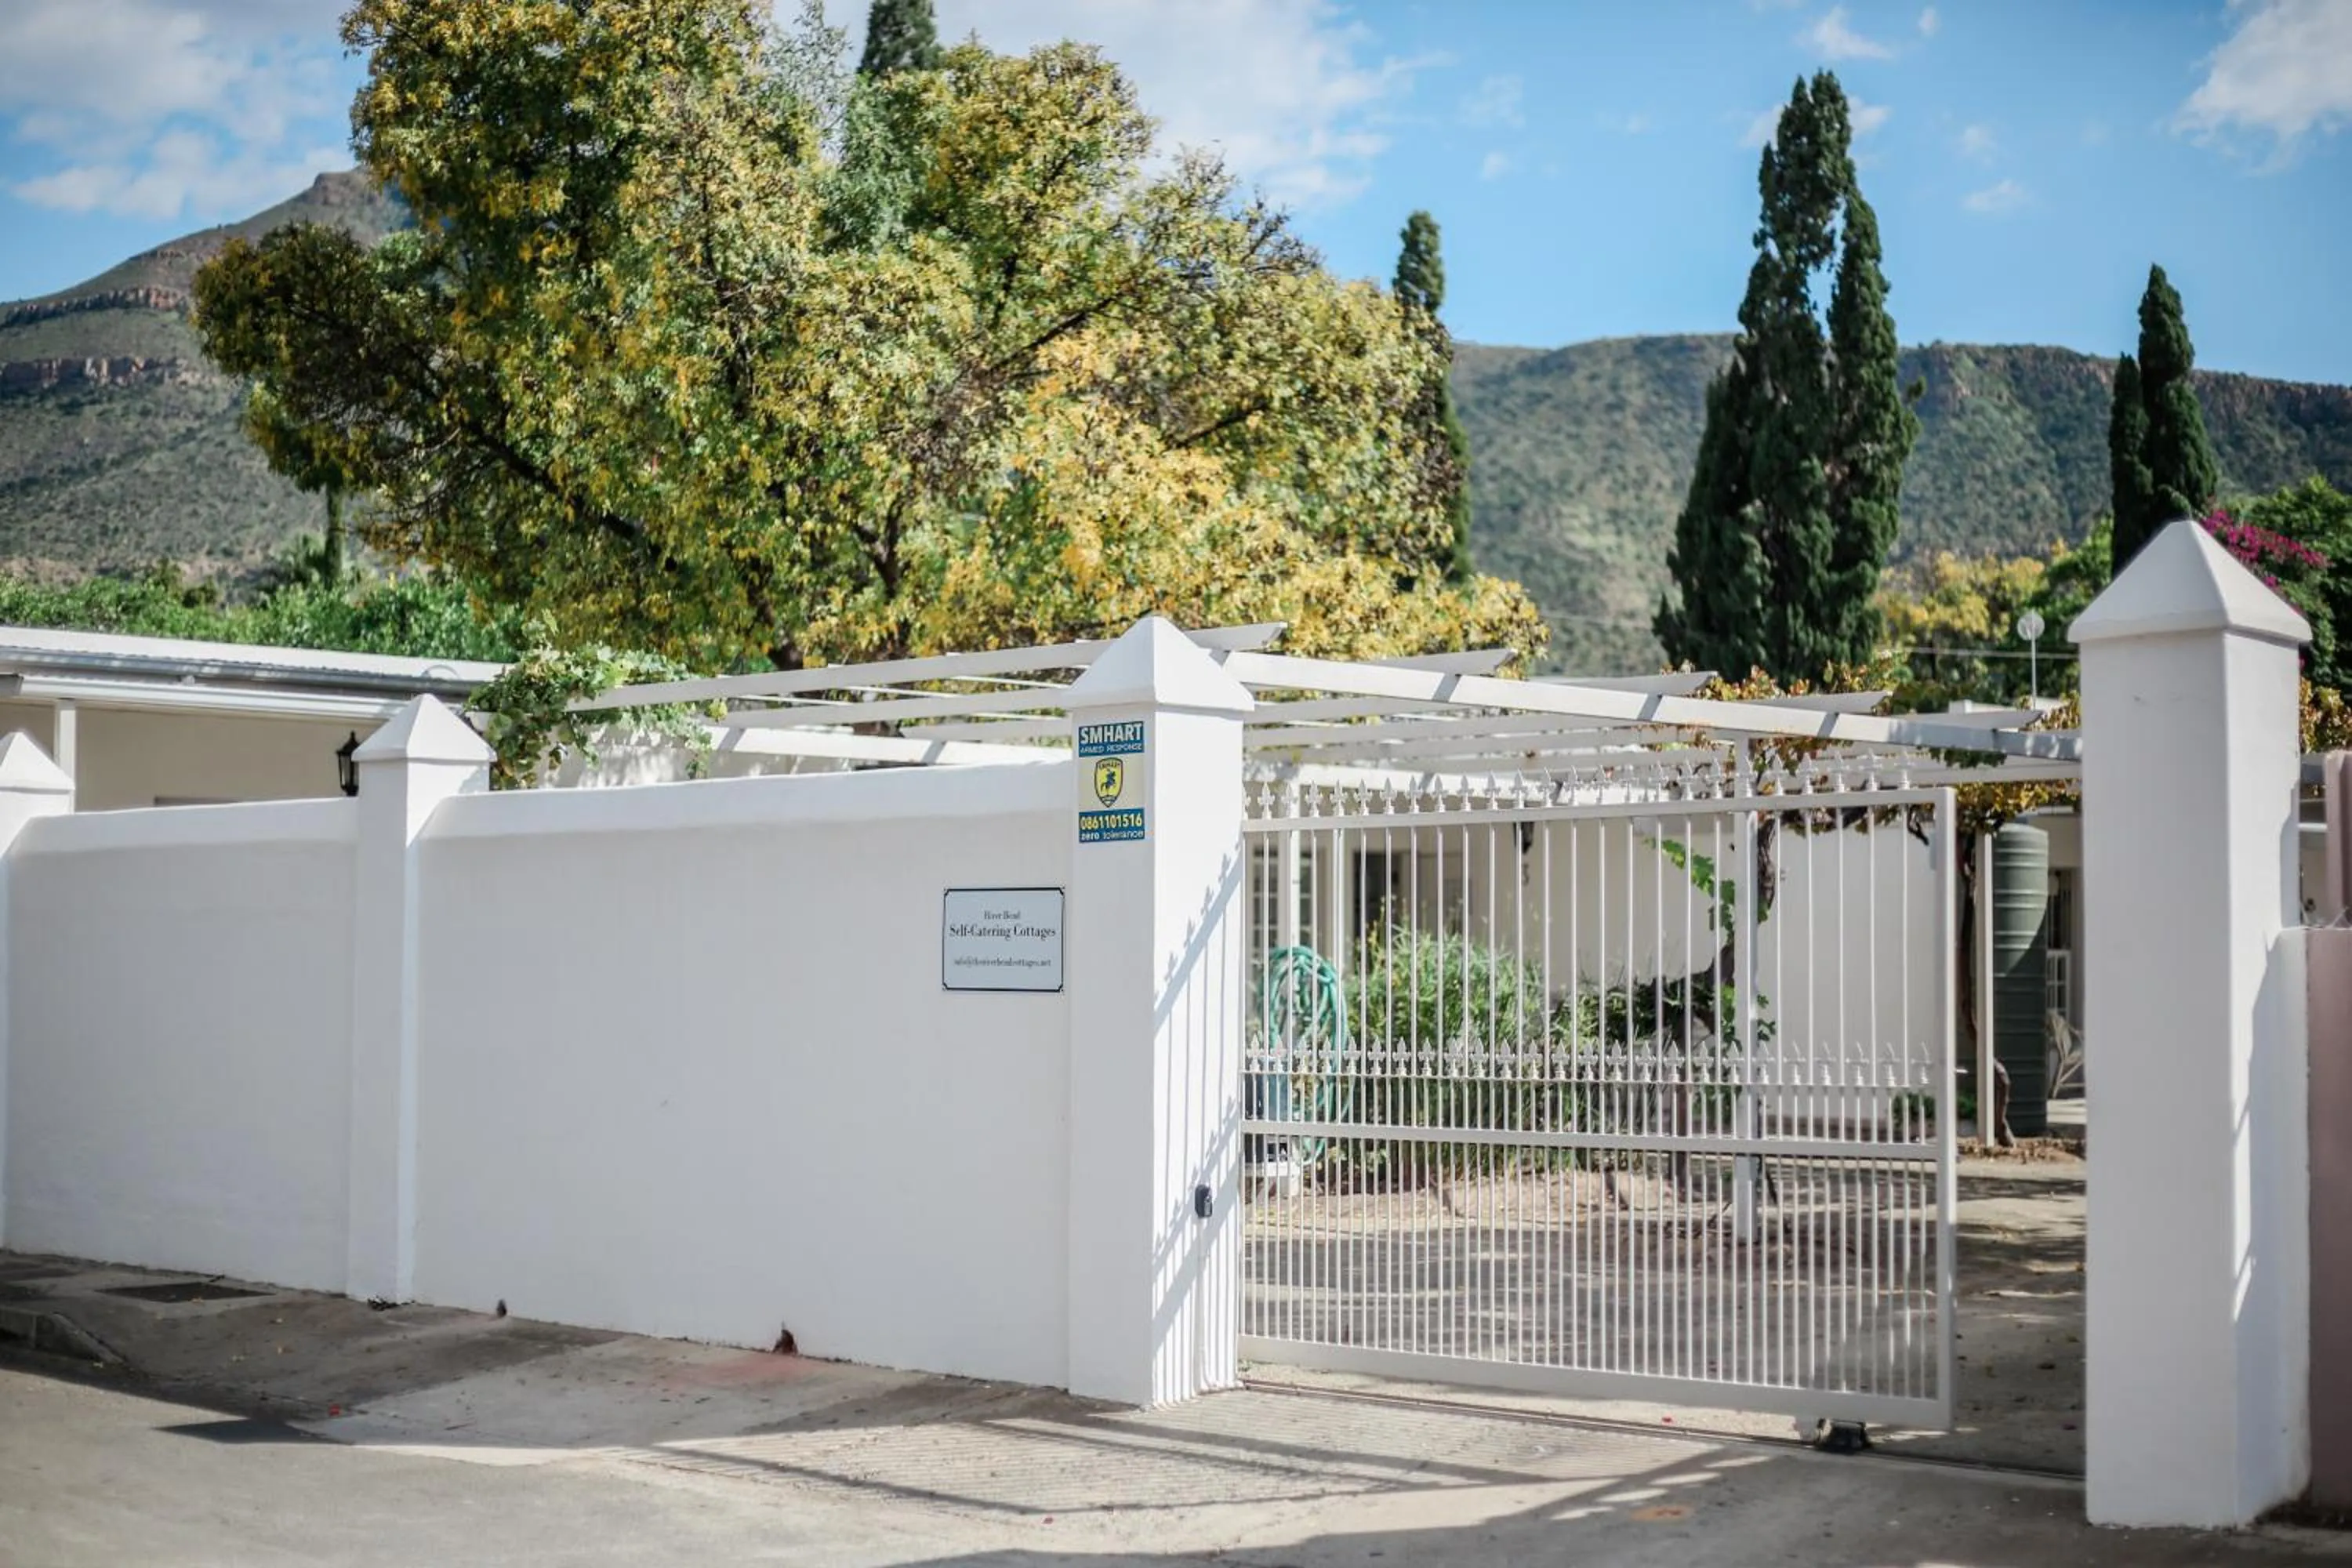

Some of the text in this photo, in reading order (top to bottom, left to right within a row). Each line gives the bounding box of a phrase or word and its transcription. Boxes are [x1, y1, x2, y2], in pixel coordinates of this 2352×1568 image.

[1080, 723, 1142, 744] SMHART
[1080, 813, 1142, 829] 0861101516
[949, 924, 1056, 941] Self-Catering Cottages
